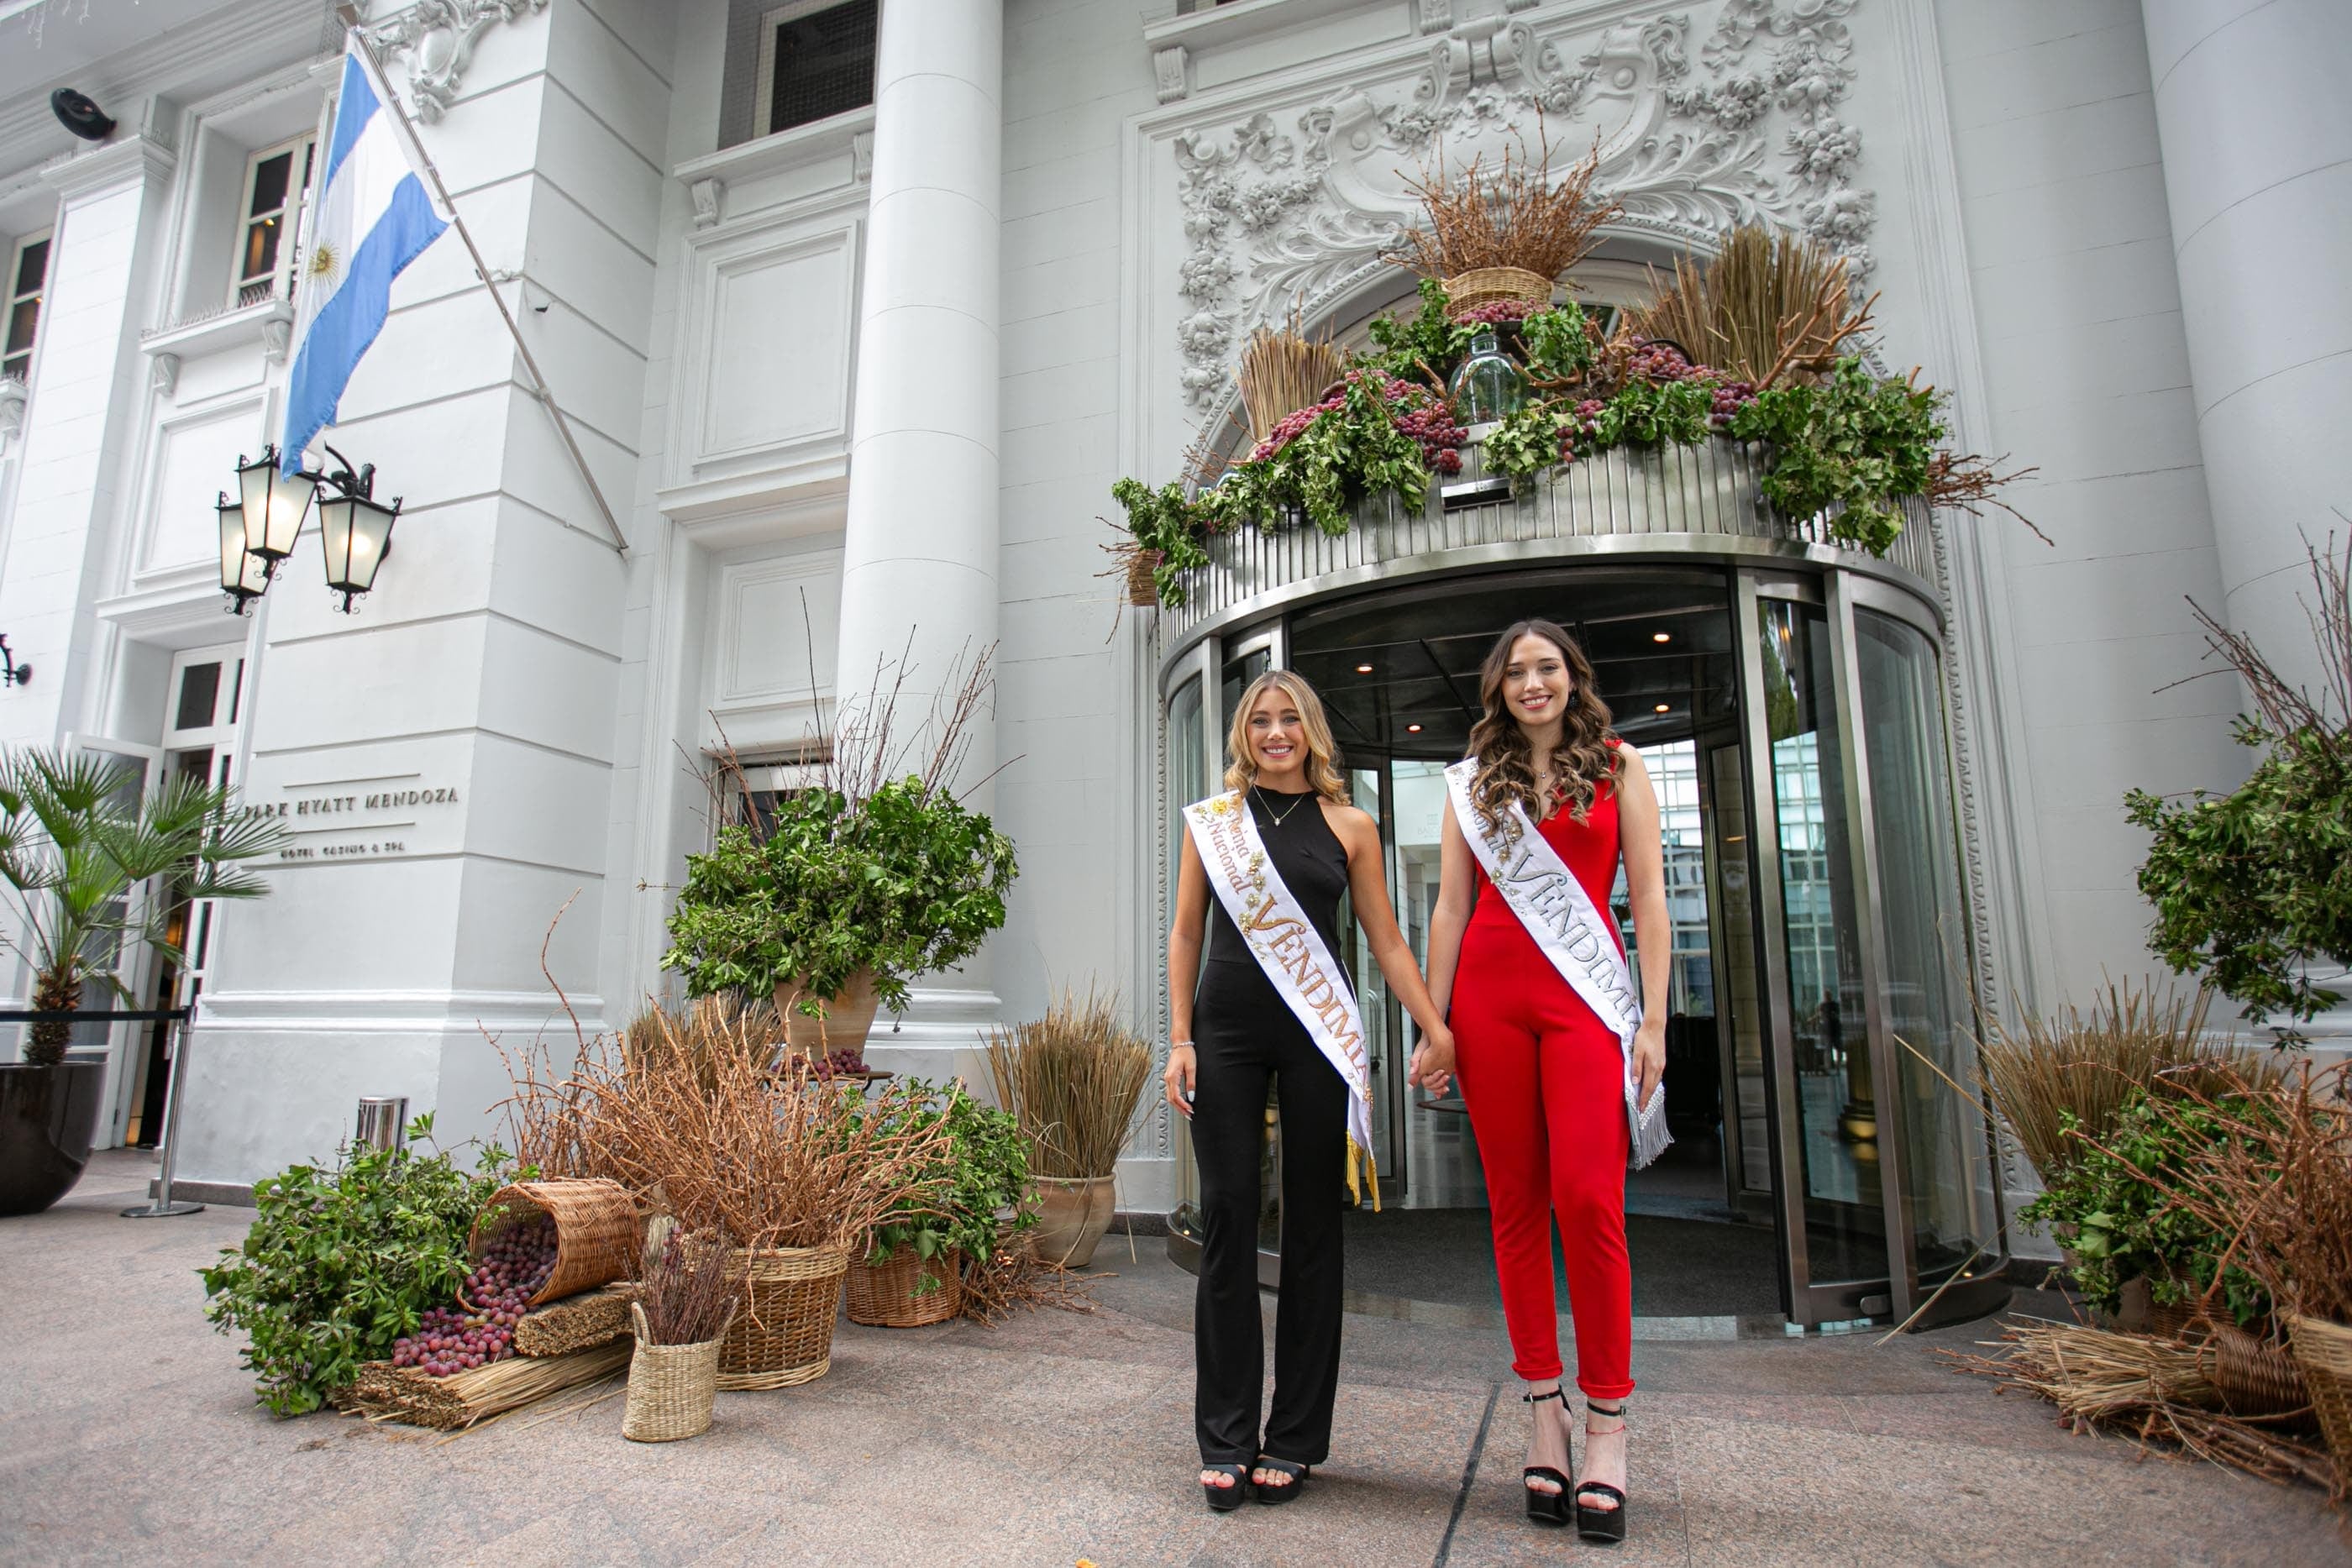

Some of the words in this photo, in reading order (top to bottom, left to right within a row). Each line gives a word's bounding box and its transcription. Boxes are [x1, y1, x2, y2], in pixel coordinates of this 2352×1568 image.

[297, 796, 357, 815] HYATT
[365, 788, 459, 810] MENDOZA
[1207, 817, 1252, 894] Nacional
